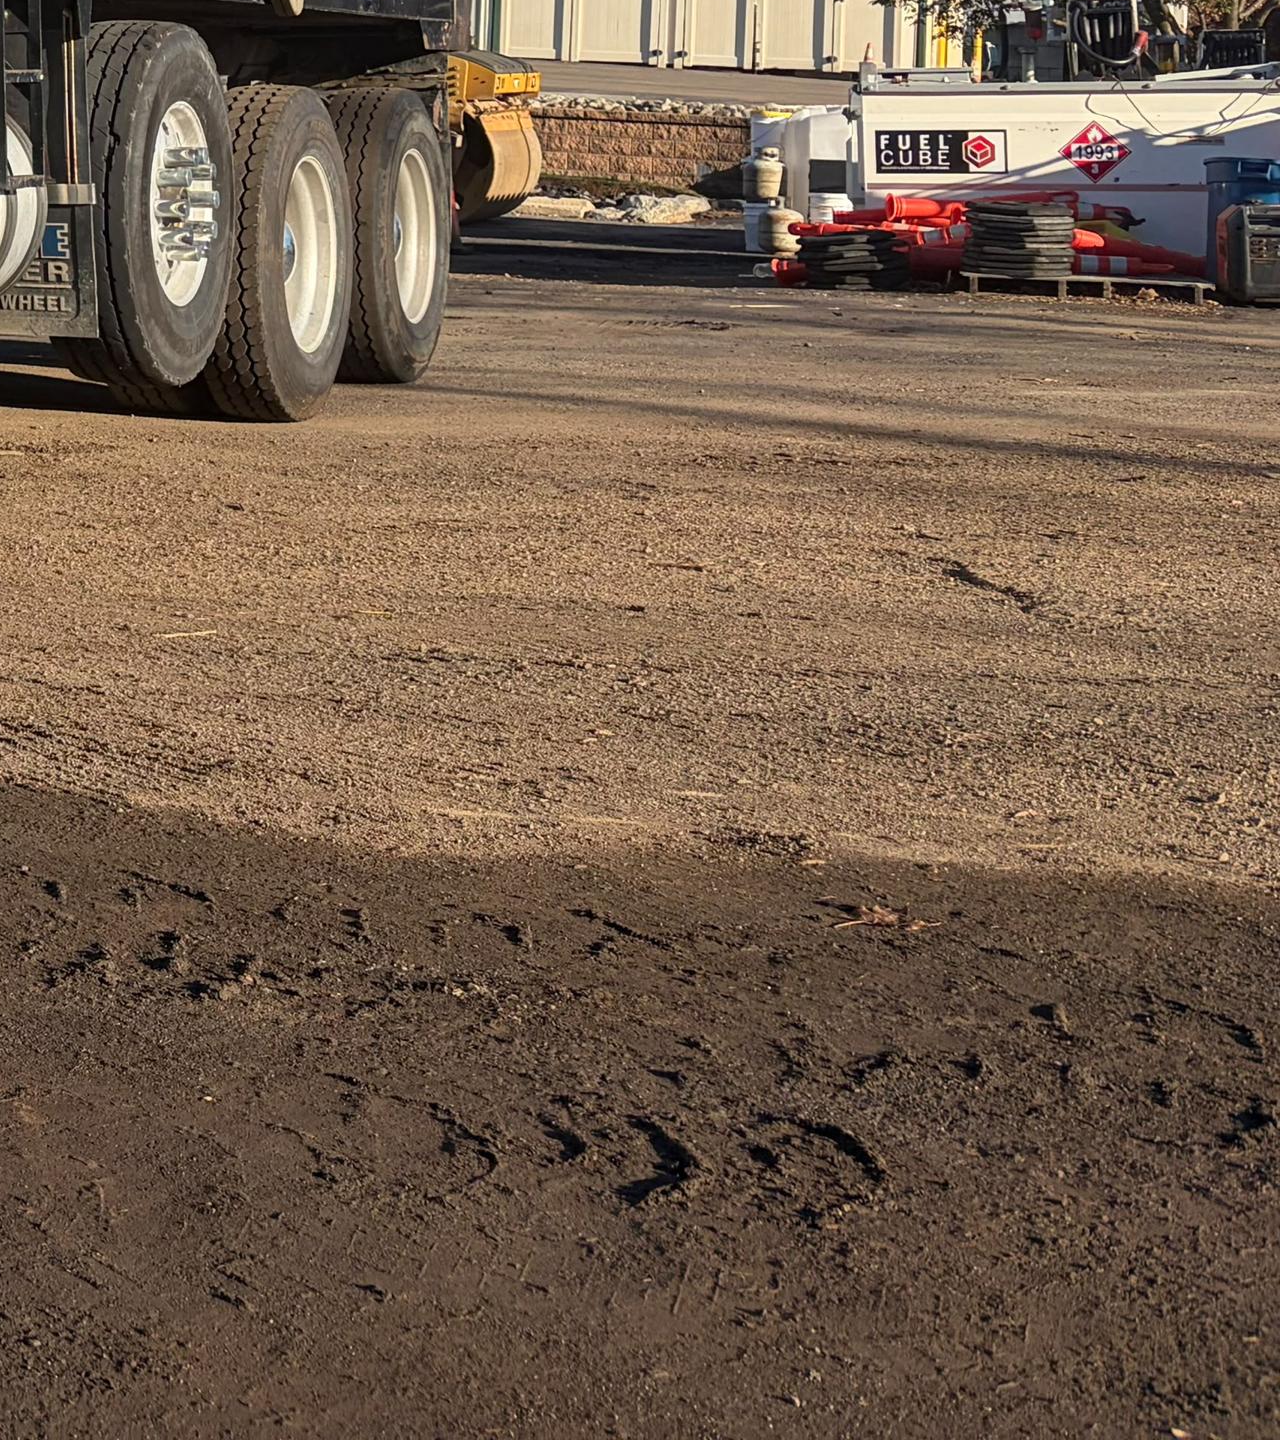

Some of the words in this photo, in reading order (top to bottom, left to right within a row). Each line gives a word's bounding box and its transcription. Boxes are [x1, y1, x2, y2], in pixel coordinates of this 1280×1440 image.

[880, 134, 950, 150] FUEL
[881, 149, 951, 166] CUBE
[1074, 144, 1115, 161] 1993
[1090, 162, 1100, 175] 3
[0, 293, 73, 313] WHEEL
